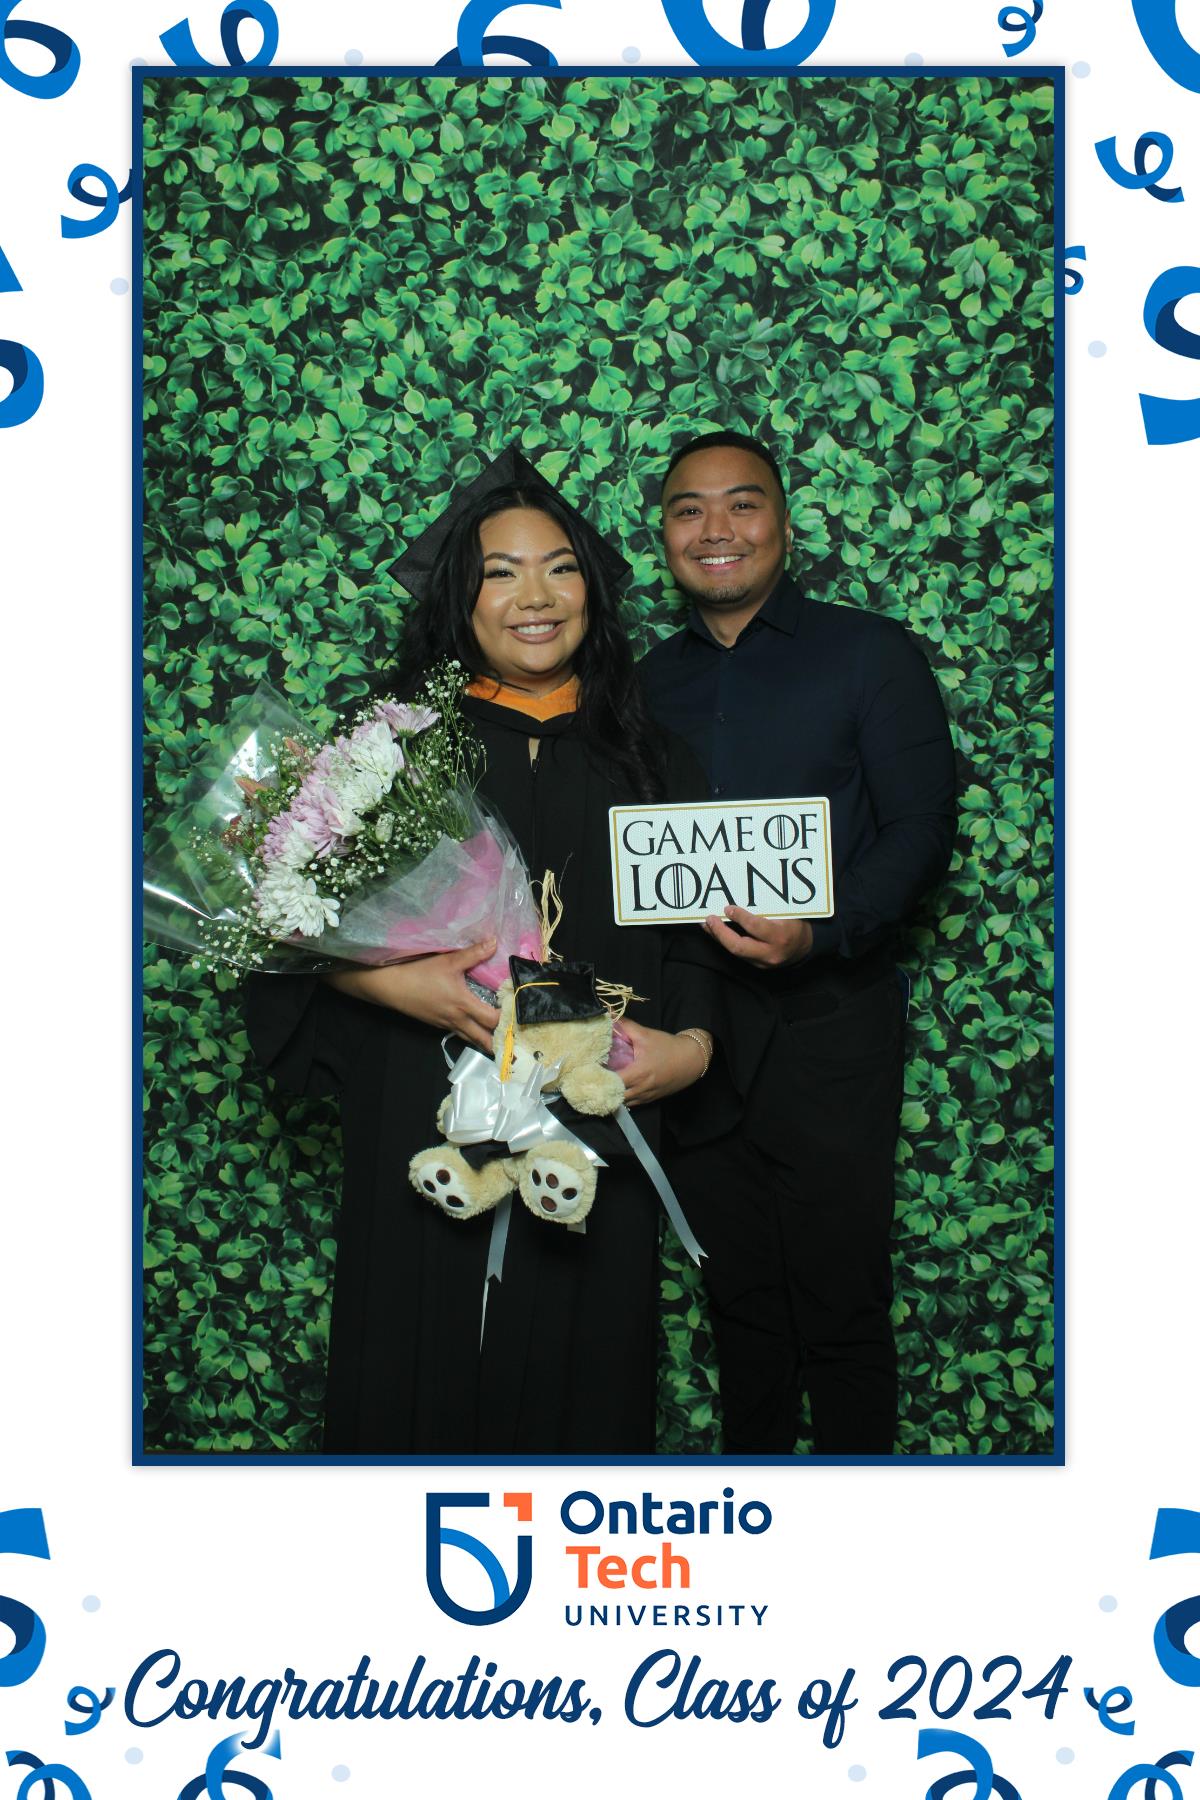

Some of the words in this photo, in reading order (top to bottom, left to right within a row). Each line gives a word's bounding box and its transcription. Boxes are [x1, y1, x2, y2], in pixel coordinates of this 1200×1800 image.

[622, 816, 755, 856] GAME
[763, 813, 817, 850] OF
[630, 857, 816, 911] LOANS
